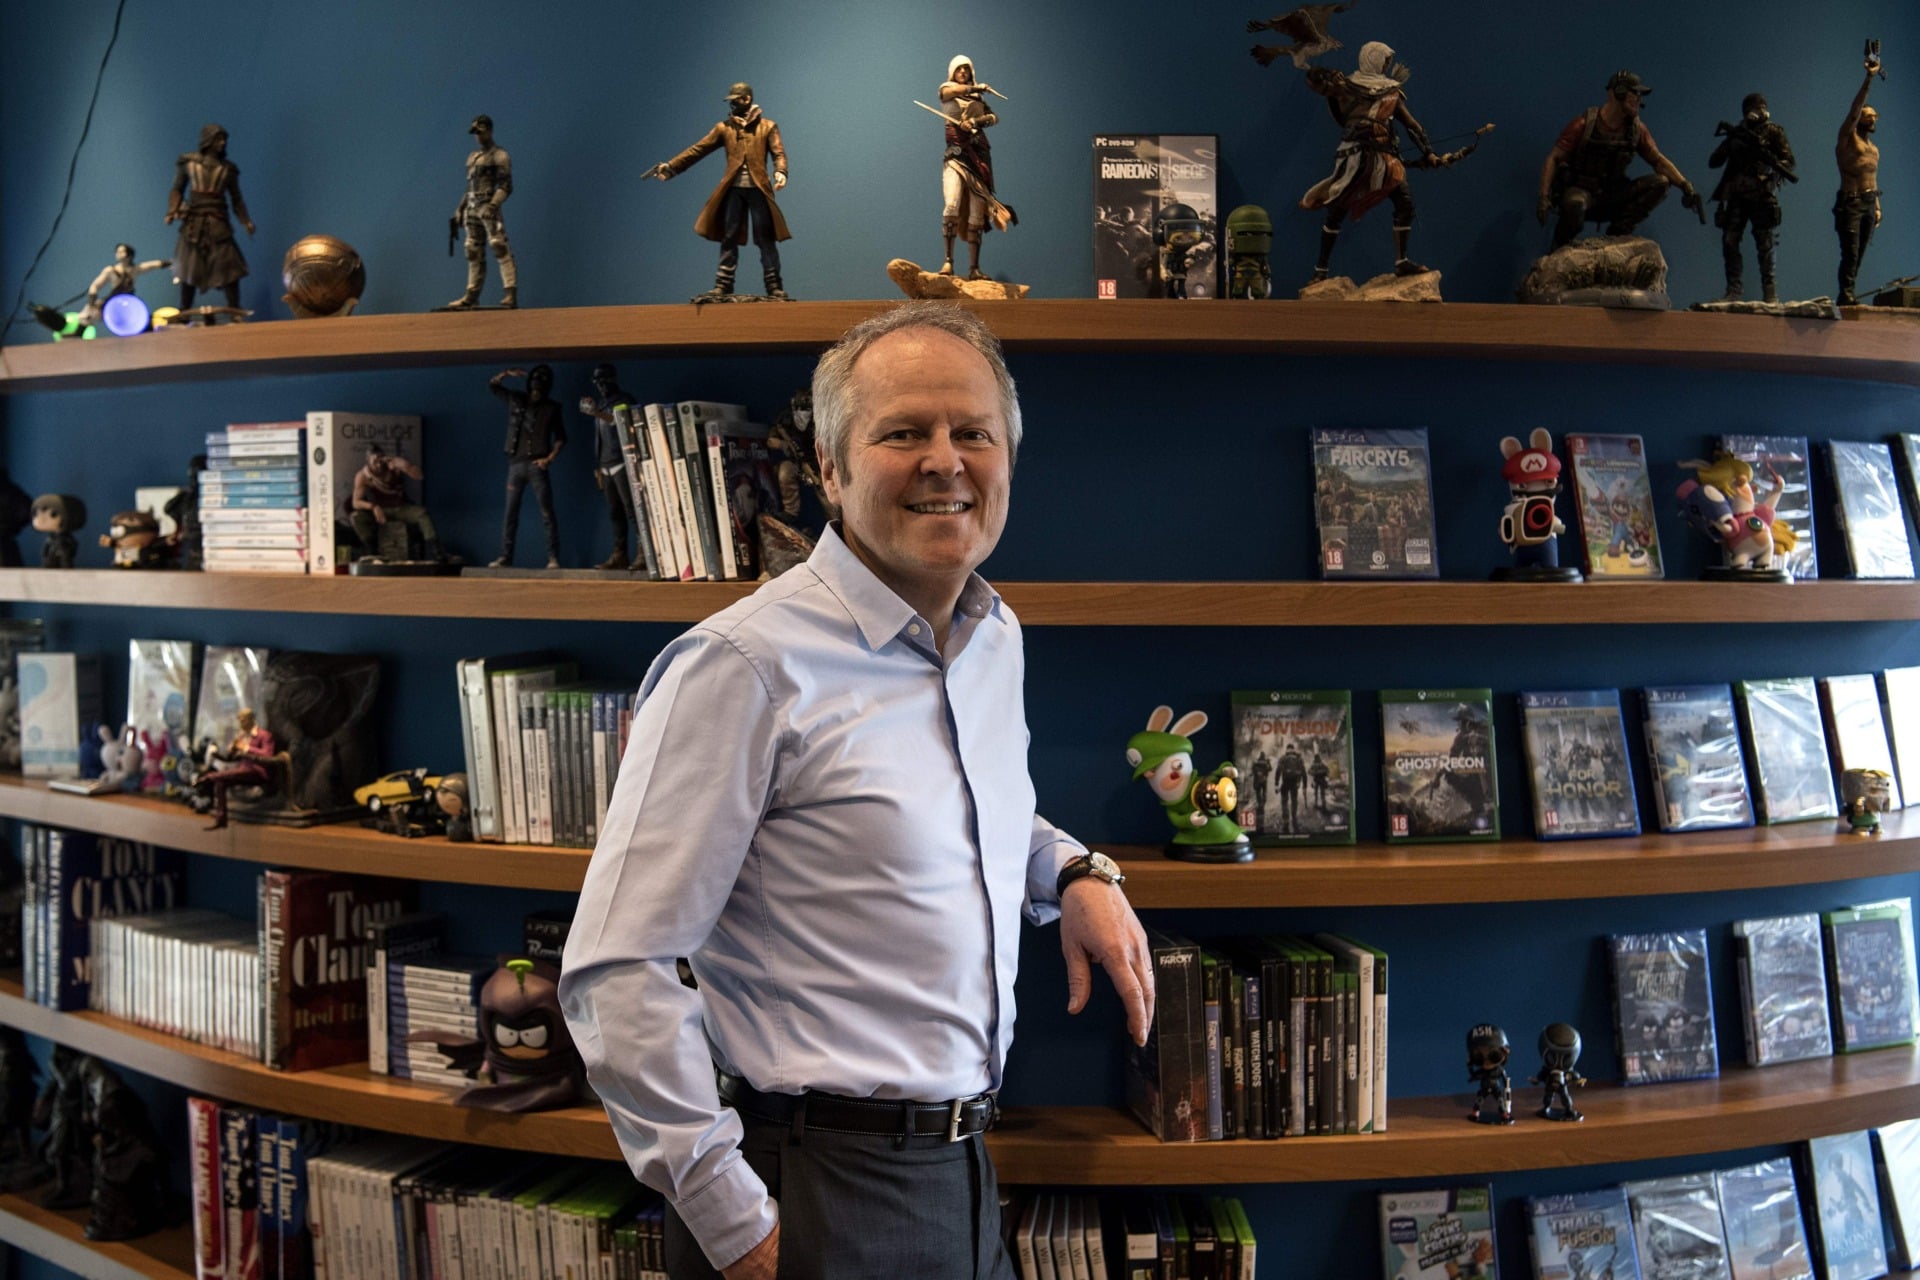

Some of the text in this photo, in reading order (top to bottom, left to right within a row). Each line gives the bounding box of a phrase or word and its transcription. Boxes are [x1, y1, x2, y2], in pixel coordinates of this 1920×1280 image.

[1096, 138, 1107, 147] PC
[1101, 163, 1151, 179] RAINBOW
[1173, 164, 1206, 179] SIEGE
[1099, 282, 1115, 294] 18
[648, 414, 659, 432] Wii
[342, 423, 377, 440] CHILD
[384, 425, 415, 441] LIGHT
[676, 461, 685, 481] Prince
[682, 490, 691, 510] Persia
[711, 456, 719, 476] Prince
[715, 485, 724, 506] Persia
[1327, 551, 1342, 564] 18
[1260, 720, 1338, 736] DIVISION
[1395, 758, 1438, 770] GHOST
[1439, 756, 1485, 772] RECON
[1568, 770, 1595, 781] FOR
[1545, 781, 1624, 799] HONOR
[1240, 813, 1254, 826] 18
[1393, 817, 1407, 829] 18
[96, 838, 158, 878] TOM
[270, 886, 284, 923] Tom
[327, 889, 403, 941] Tom
[1159, 953, 1193, 966] FARCRY
[1362, 966, 1371, 983] Wii
[294, 1007, 334, 1029] Red
[1551, 1213, 1604, 1233] TRIALS
[1559, 1228, 1615, 1249] FUSION
[1021, 1247, 1031, 1264] Wii
[1039, 1246, 1049, 1264] Wii
[1057, 1249, 1067, 1266] Wii
[1072, 1248, 1082, 1265] Wii
[1092, 1247, 1103, 1264] Wii
